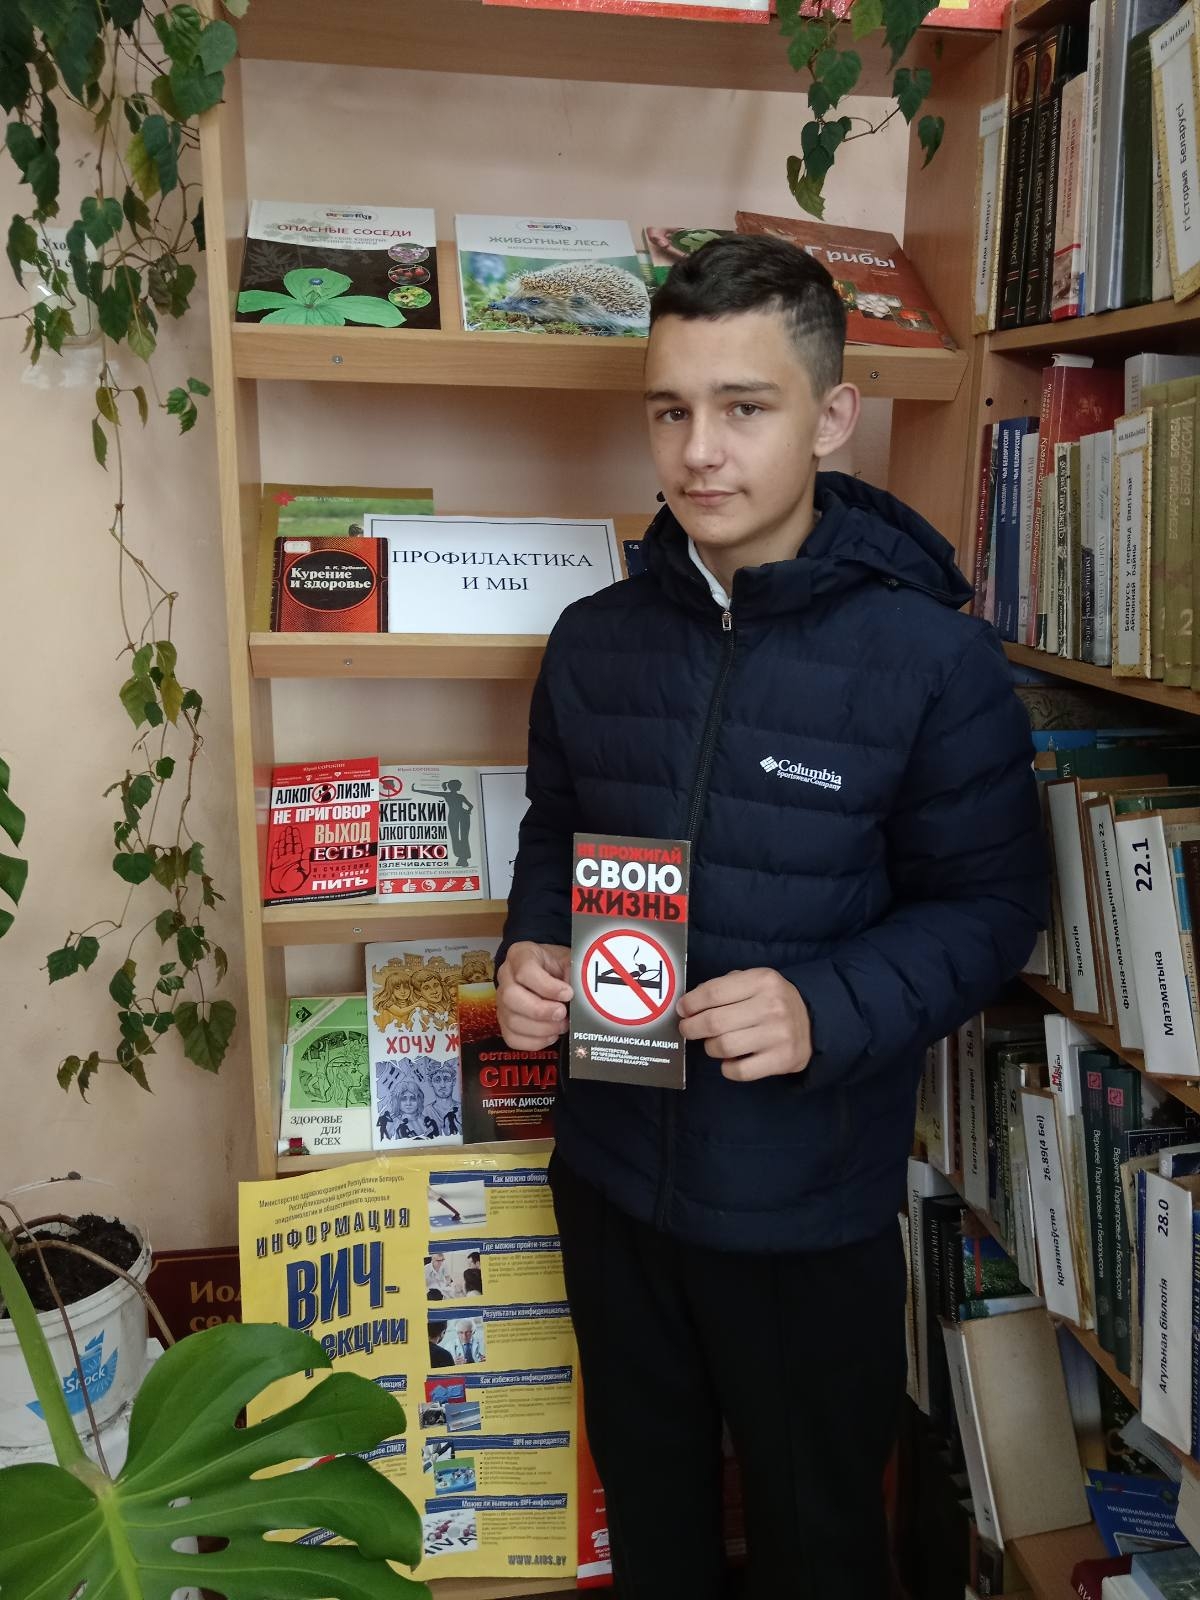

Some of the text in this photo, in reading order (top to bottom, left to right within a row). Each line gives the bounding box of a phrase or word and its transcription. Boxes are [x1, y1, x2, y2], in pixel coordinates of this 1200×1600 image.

[1175, 103, 1192, 232] Гісторыя Беларусі
[277, 224, 412, 238] ОПАСНЫЕ СОСЕДИ
[489, 235, 609, 247] ЖИВОТНЫЕ ЛЕСА
[804, 245, 897, 270] Грибы
[1181, 415, 1193, 496] БЕЛОРУССИИ
[1168, 416, 1181, 540] ВСЕНАРОДНАЯ БОРЬБА
[392, 550, 593, 568] ПРОФИЛАКТИКА
[291, 567, 352, 582] Курение
[304, 580, 372, 591] здоровье
[461, 576, 529, 591] И МЫ
[1124, 582, 1132, 632] Беларусь
[1177, 608, 1193, 636] 2
[778, 759, 842, 785] Columbia
[273, 804, 371, 824] НЕ ПРИГОВОР
[314, 821, 371, 845] ВЫХОД
[313, 843, 370, 861] ЕСТЬ!
[379, 845, 447, 860] ЛЕГКО
[576, 842, 683, 864] НЕ ПРОЖИГАЙ
[1100, 840, 1110, 868] навукі
[311, 877, 369, 891] ПИТЬ
[575, 858, 683, 895] СВОЮ
[576, 887, 681, 921] ЖИЗНЬ
[1103, 869, 1130, 1010] Фізіка-матэматычныя
[1131, 837, 1174, 1037] Матэматыка 22.1
[1071, 925, 1084, 977] Экалогія
[386, 1035, 460, 1054] ХОЧУ Ж
[573, 1032, 679, 1050] РЕСПУБЛИКАНСКАЯ АКЦИЯ
[479, 1065, 557, 1090] СПИД
[482, 1098, 518, 1108] ПАТРИК
[290, 1114, 343, 1126] ЗДОРОВЬЕ
[320, 1125, 342, 1135] ДЛЯ
[313, 1136, 342, 1147] ВСЕХ
[1093, 1129, 1101, 1164] Верхнее
[1039, 1139, 1052, 1182] 26.89(4
[1113, 1147, 1121, 1183] Верхнее
[492, 1175, 526, 1183] Как можно
[259, 1194, 300, 1208] Министерство
[300, 1183, 347, 1200] здравоохранения
[347, 1177, 378, 1188] Республики
[288, 1195, 335, 1212] Республиканский
[336, 1192, 352, 1202] центр
[274, 1209, 318, 1225] эпидемиологии
[323, 1197, 363, 1214] общественного
[364, 1195, 390, 1203] здоровья
[256, 1208, 410, 1258] ИНФОРМАЦИЯ
[482, 1242, 494, 1251] Где
[494, 1242, 516, 1250] можно
[516, 1241, 538, 1250] пройти
[1048, 1208, 1065, 1287] Краязнаўства
[286, 1241, 400, 1331] ВИЧ-
[1115, 1250, 1123, 1300] Белоруссия
[1158, 1199, 1169, 1394] Агульная біялогія 28.0
[482, 1307, 571, 1319] Результаты конфиденциальн
[480, 1376, 491, 1385] Как
[492, 1374, 520, 1384] избежать
[386, 1443, 405, 1453] СПИД?
[462, 1499, 482, 1508] Можно
[490, 1499, 520, 1508] вылечить
[508, 1554, 567, 1566] WWW.AIDS.BY
